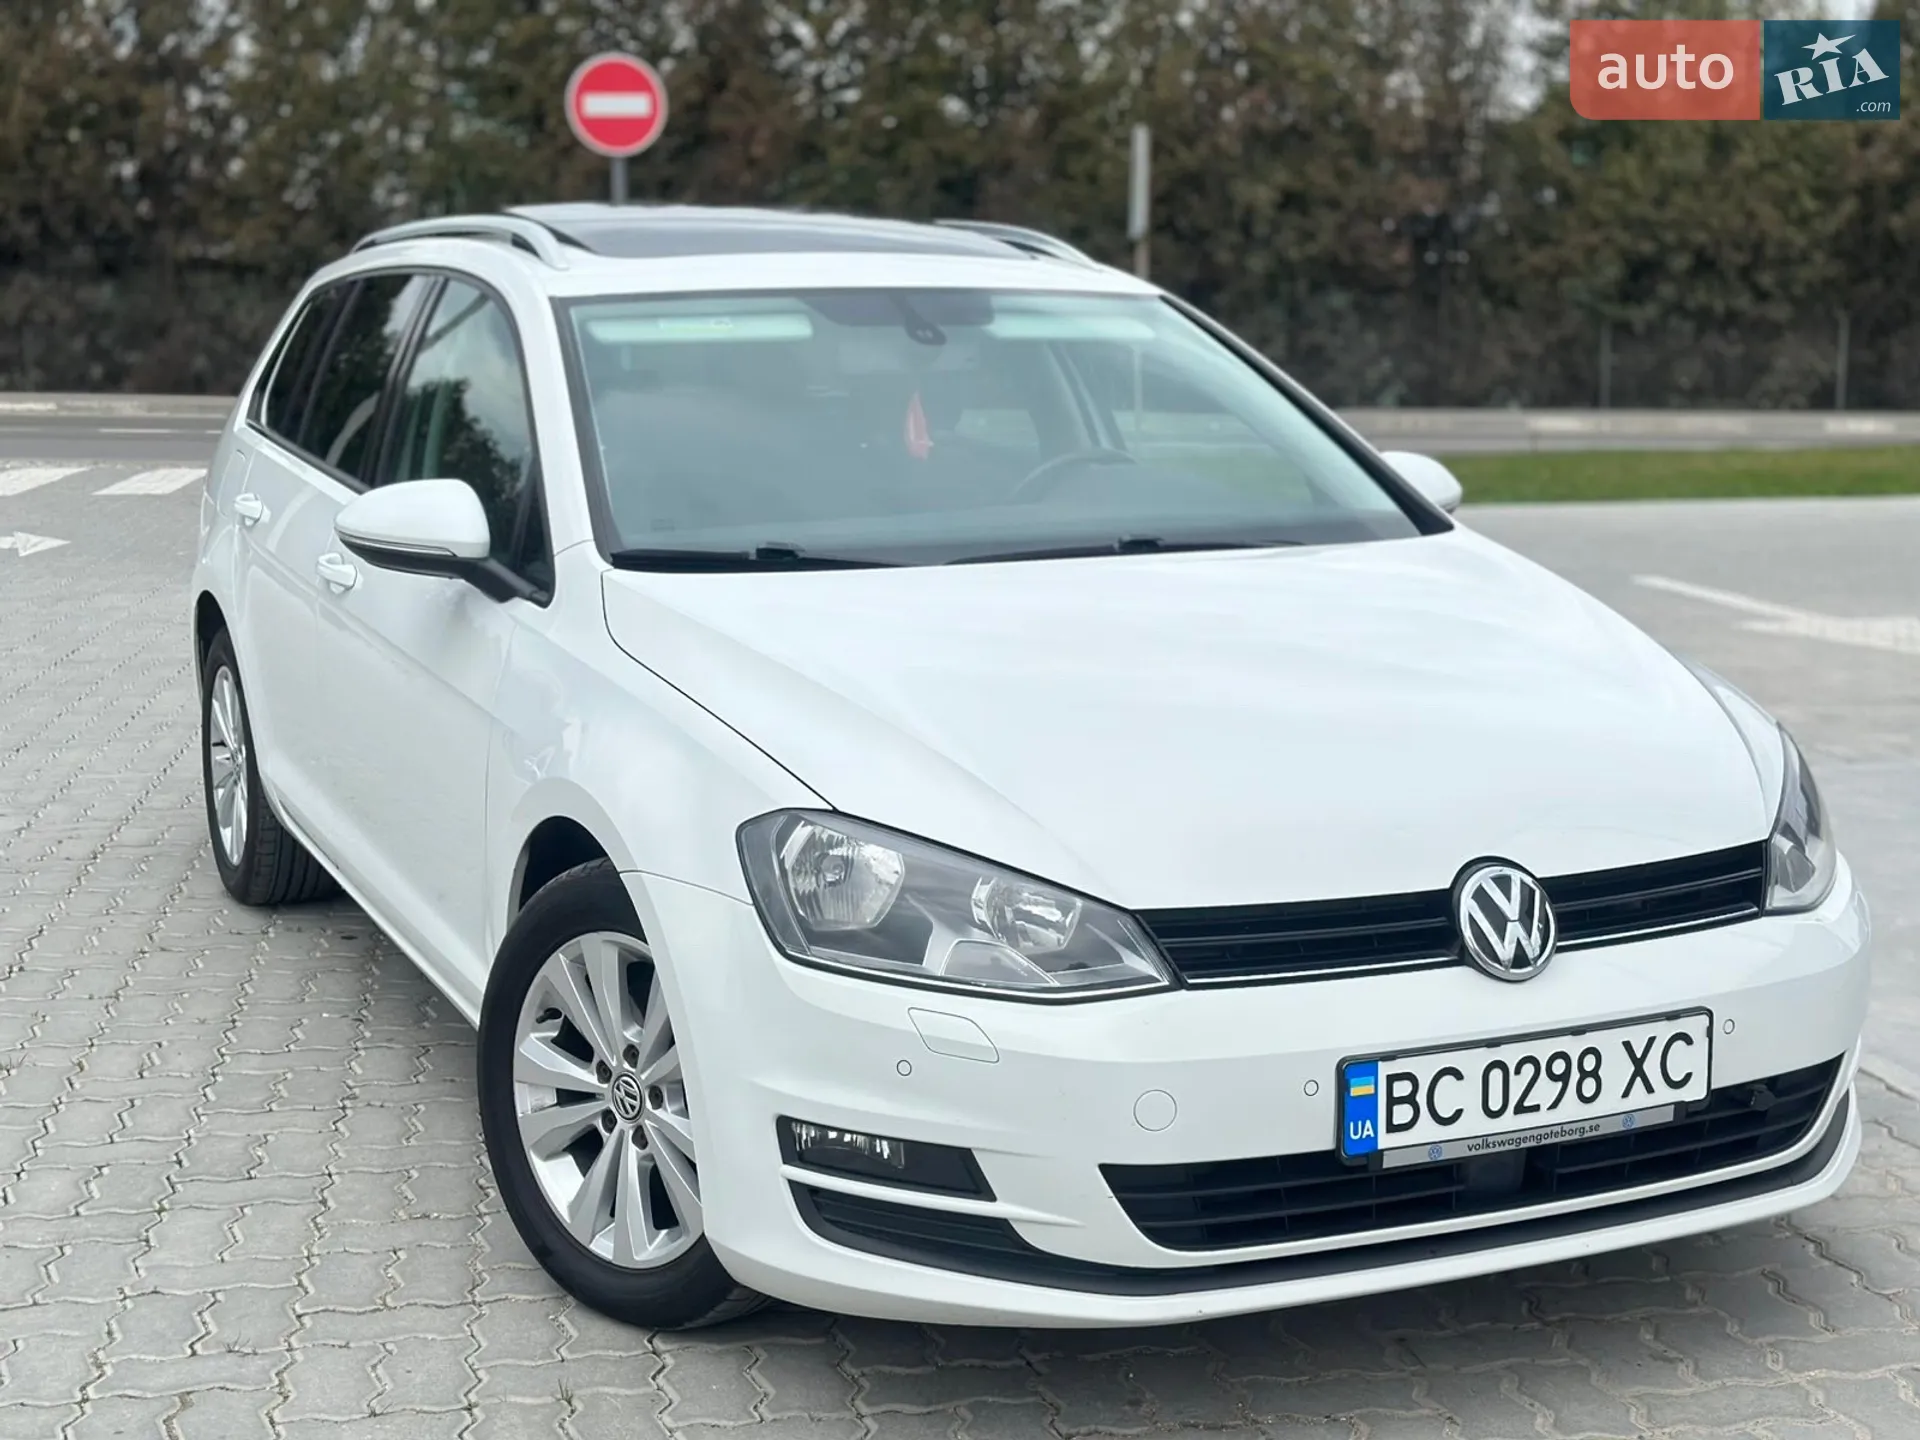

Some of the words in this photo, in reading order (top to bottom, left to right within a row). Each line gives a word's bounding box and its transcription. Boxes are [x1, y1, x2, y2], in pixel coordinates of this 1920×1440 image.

[1385, 1066, 1465, 1134] BC
[1481, 1046, 1603, 1119] 0298
[1620, 1031, 1695, 1099] XC
[1349, 1120, 1375, 1141] UA
[1467, 1123, 1601, 1152] volkswagengoteborg.se
